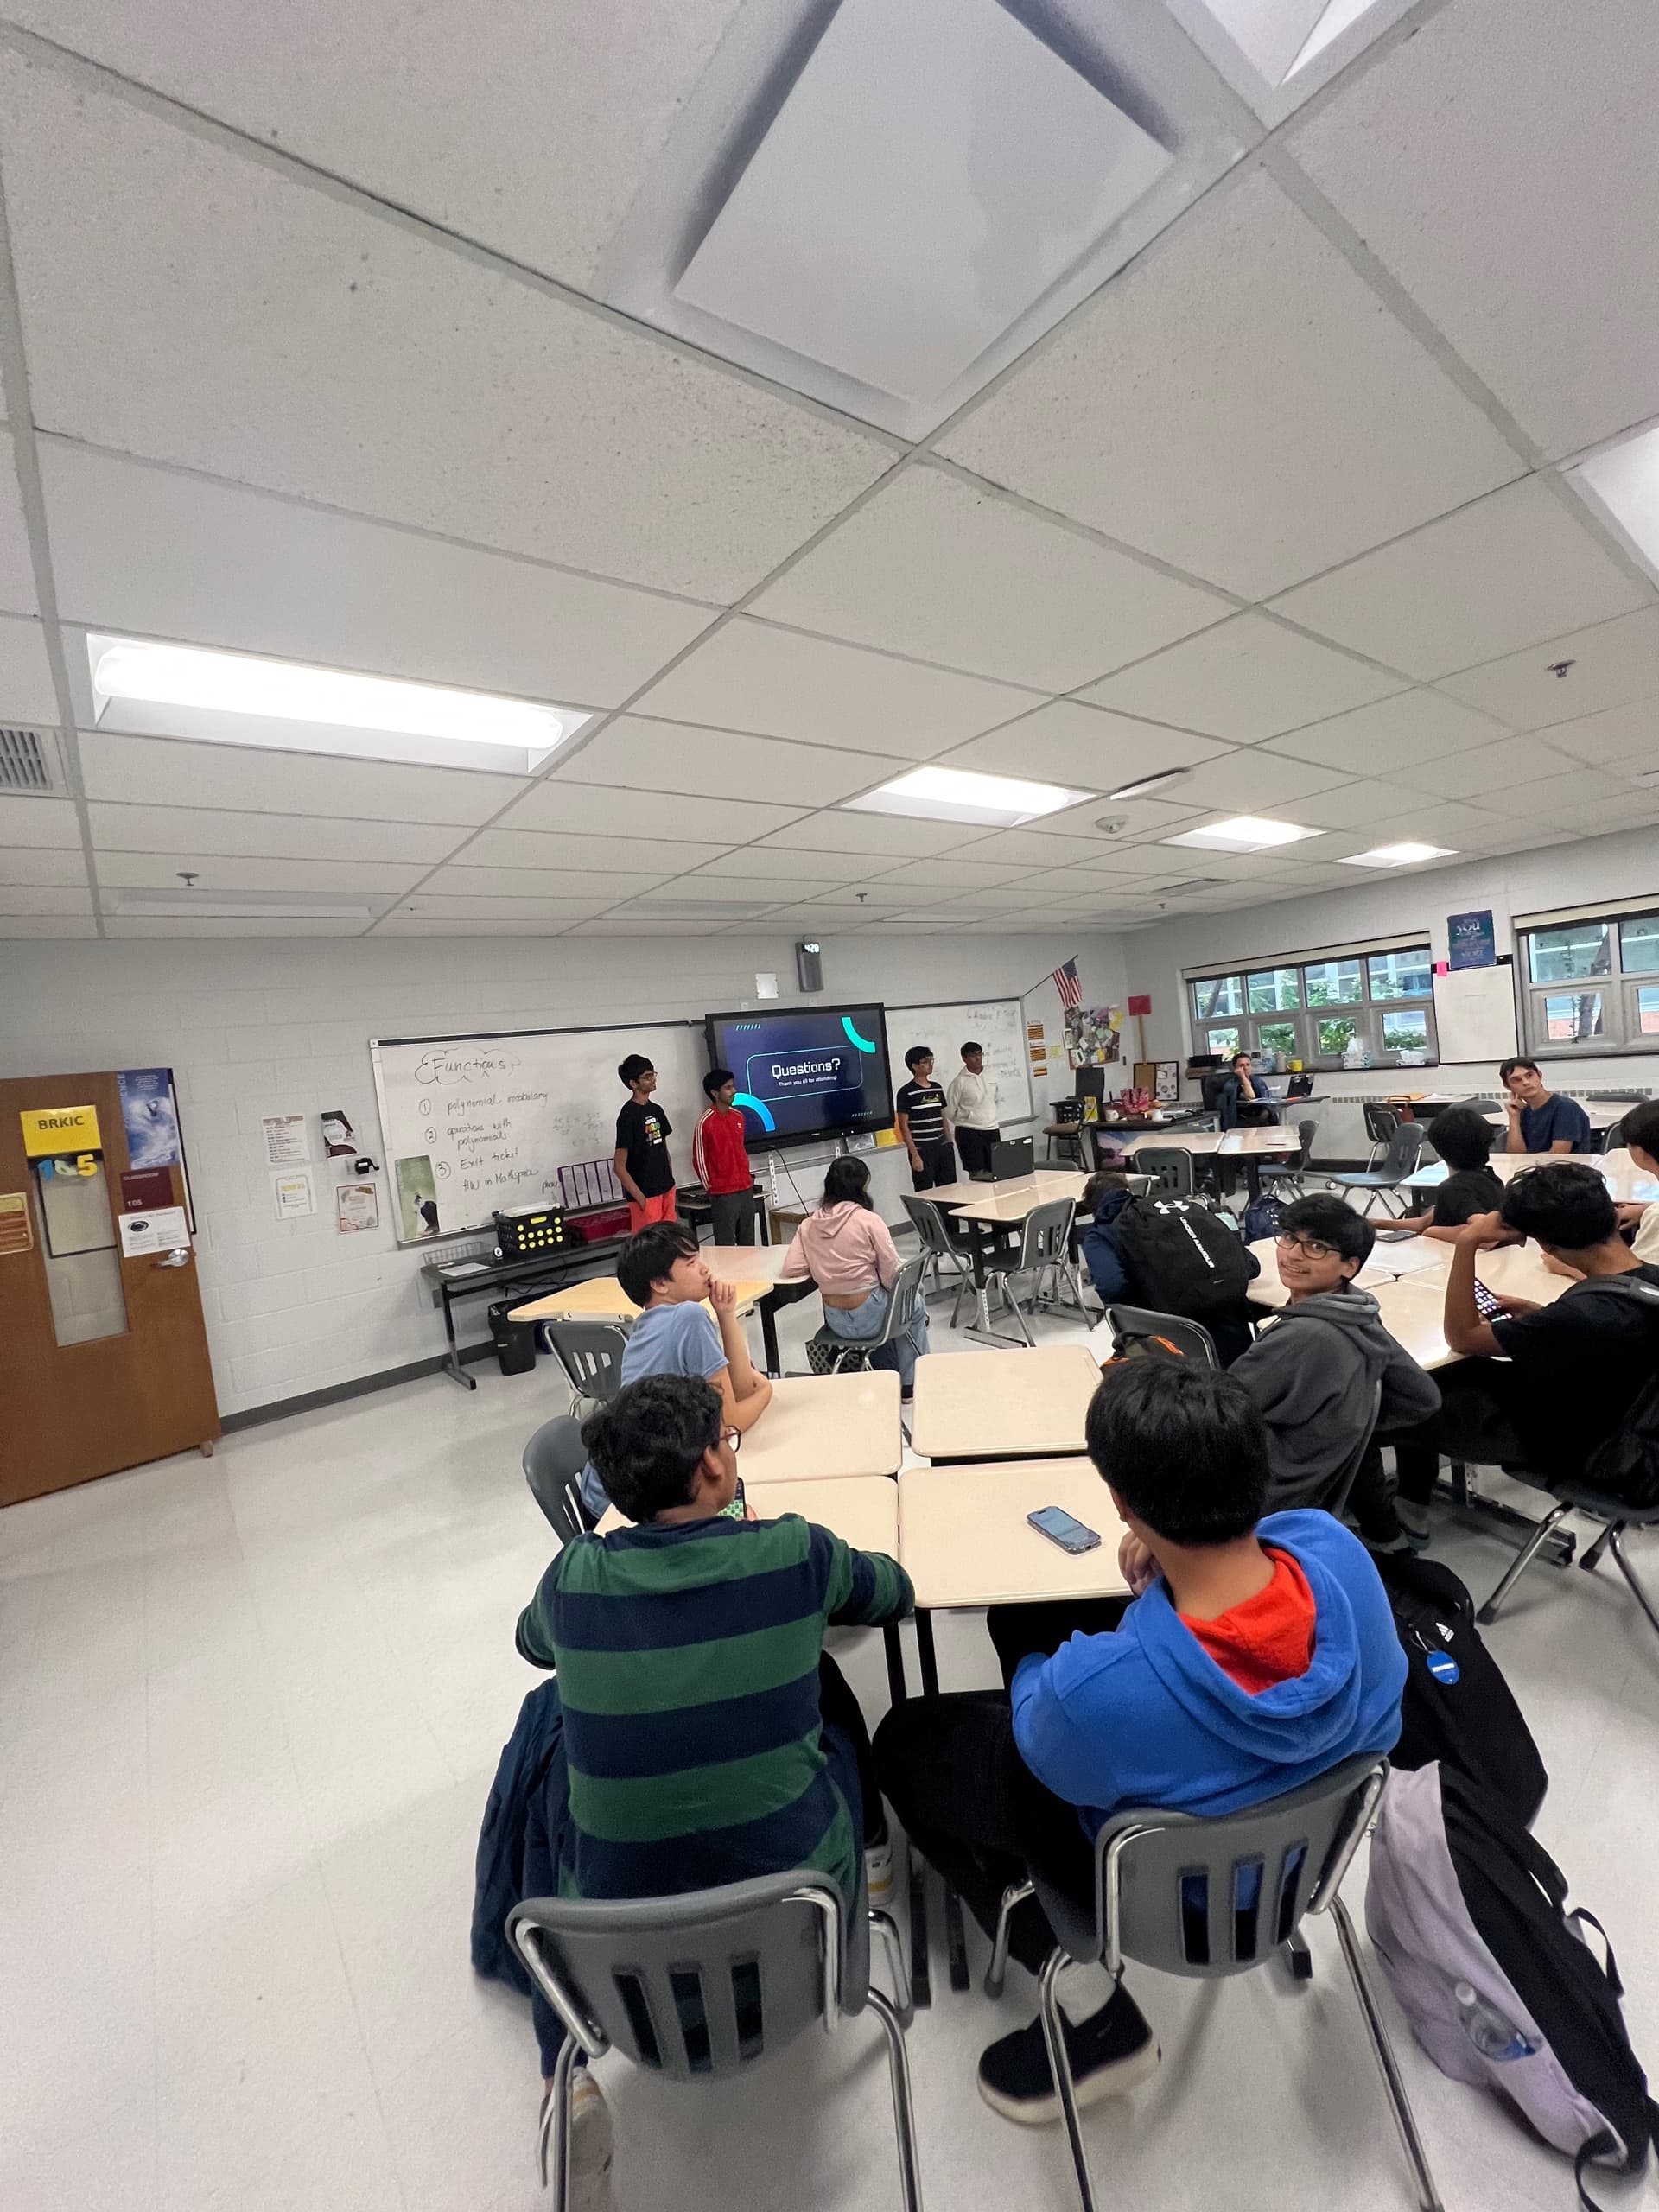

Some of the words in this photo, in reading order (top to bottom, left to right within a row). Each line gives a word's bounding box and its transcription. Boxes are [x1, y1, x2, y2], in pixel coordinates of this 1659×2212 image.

[772, 1058, 841, 1079] Questions?
[37, 1116, 85, 1130] BRKIC
[461, 1156, 484, 1169] Exit
[1179, 1216, 1198, 1239] UNDER
[1193, 1238, 1216, 1268] ARMOUR
